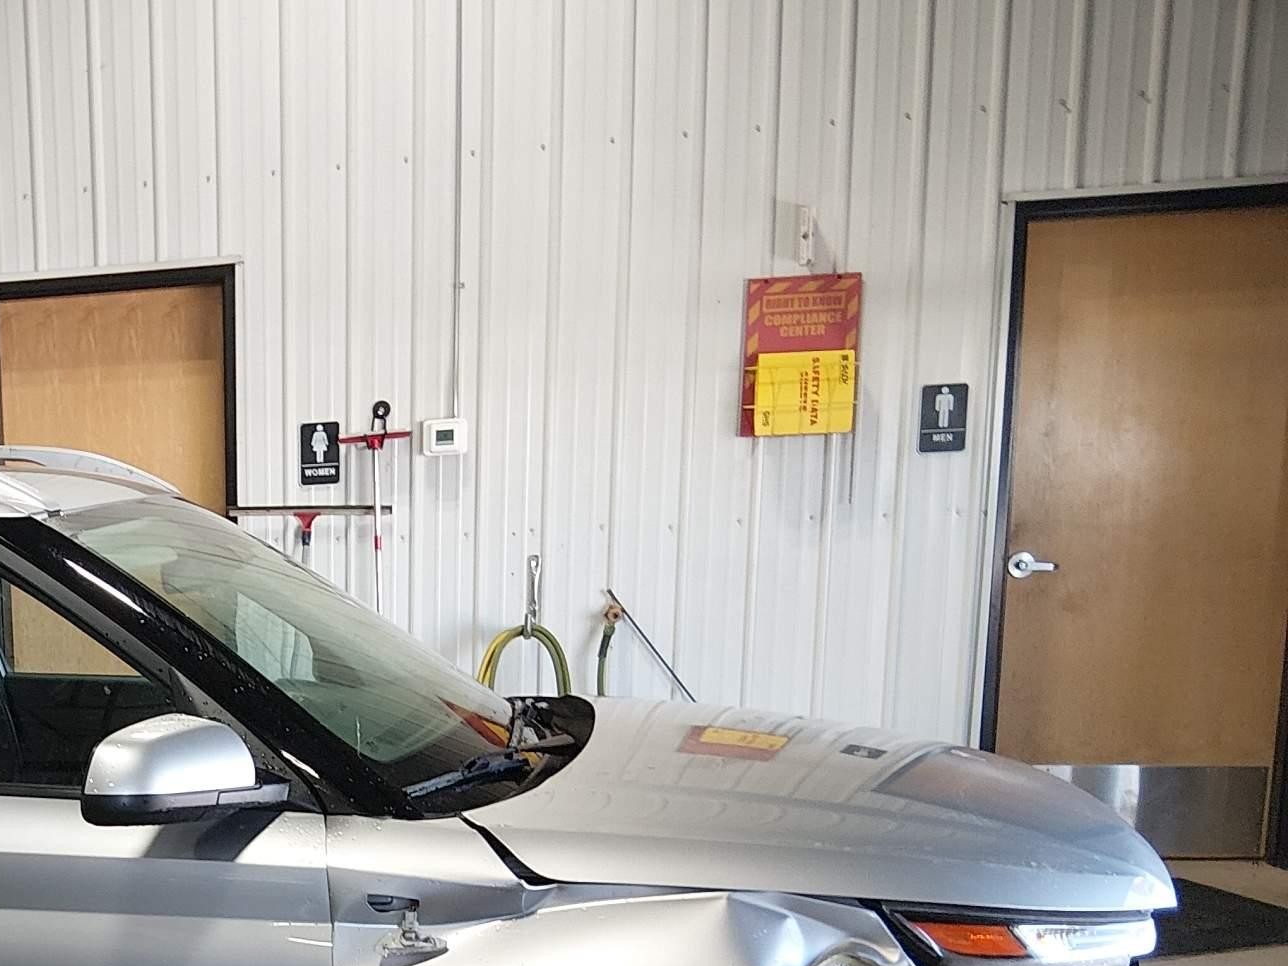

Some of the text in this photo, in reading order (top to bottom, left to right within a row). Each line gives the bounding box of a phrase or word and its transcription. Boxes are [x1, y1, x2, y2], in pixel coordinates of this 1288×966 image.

[764, 311, 842, 326] COMPLIANCE
[780, 324, 826, 336] CENTER
[932, 432, 953, 442] MEN
[304, 468, 336, 478] WOMEN
